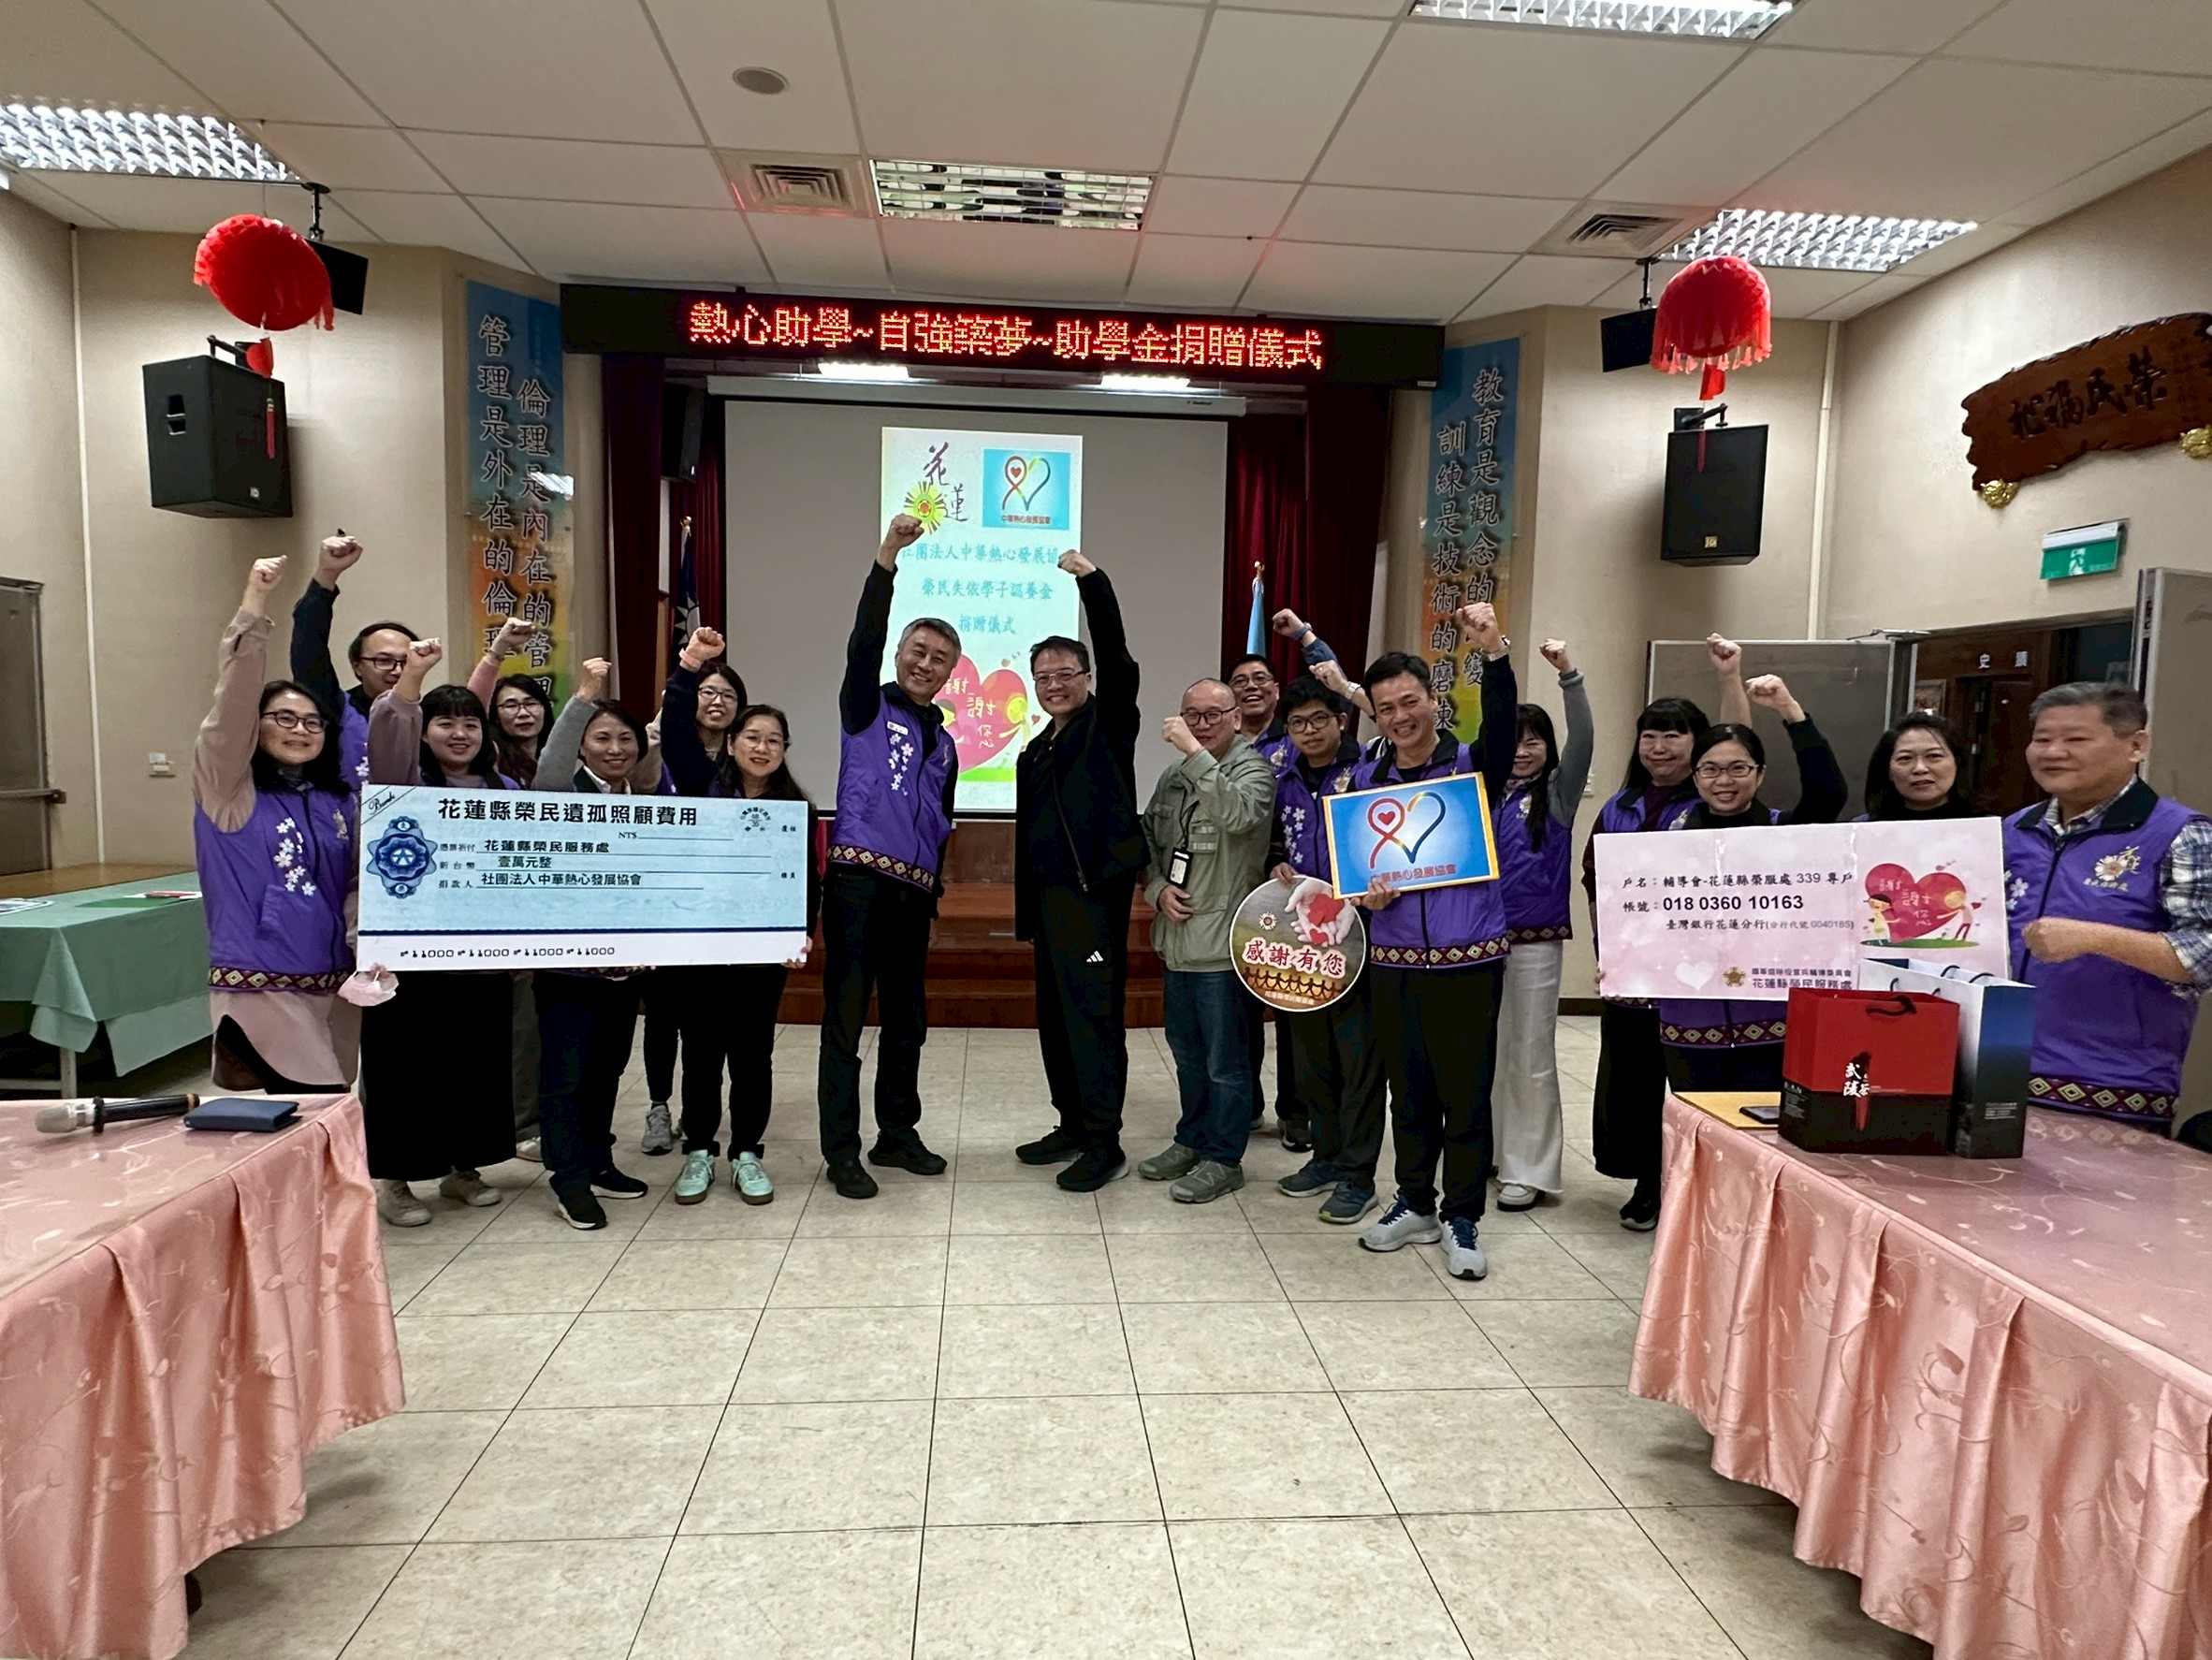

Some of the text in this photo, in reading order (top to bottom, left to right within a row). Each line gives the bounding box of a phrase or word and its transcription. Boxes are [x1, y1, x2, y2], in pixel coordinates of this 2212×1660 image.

[1462, 369, 1504, 686] 教育是觀念的變
[438, 798, 697, 826] 花蓮縣榮民遺孤照顧費用
[484, 839, 609, 853] 花蓮縣榮民服務處
[498, 856, 552, 868] 壹萬元整
[481, 872, 641, 886] 社團法人中華熱心發展協會
[1796, 872, 1821, 883] 339
[1698, 896, 1741, 910] 0360
[1748, 895, 1804, 910] 10163
[1245, 939, 1346, 976] 感謝有您
